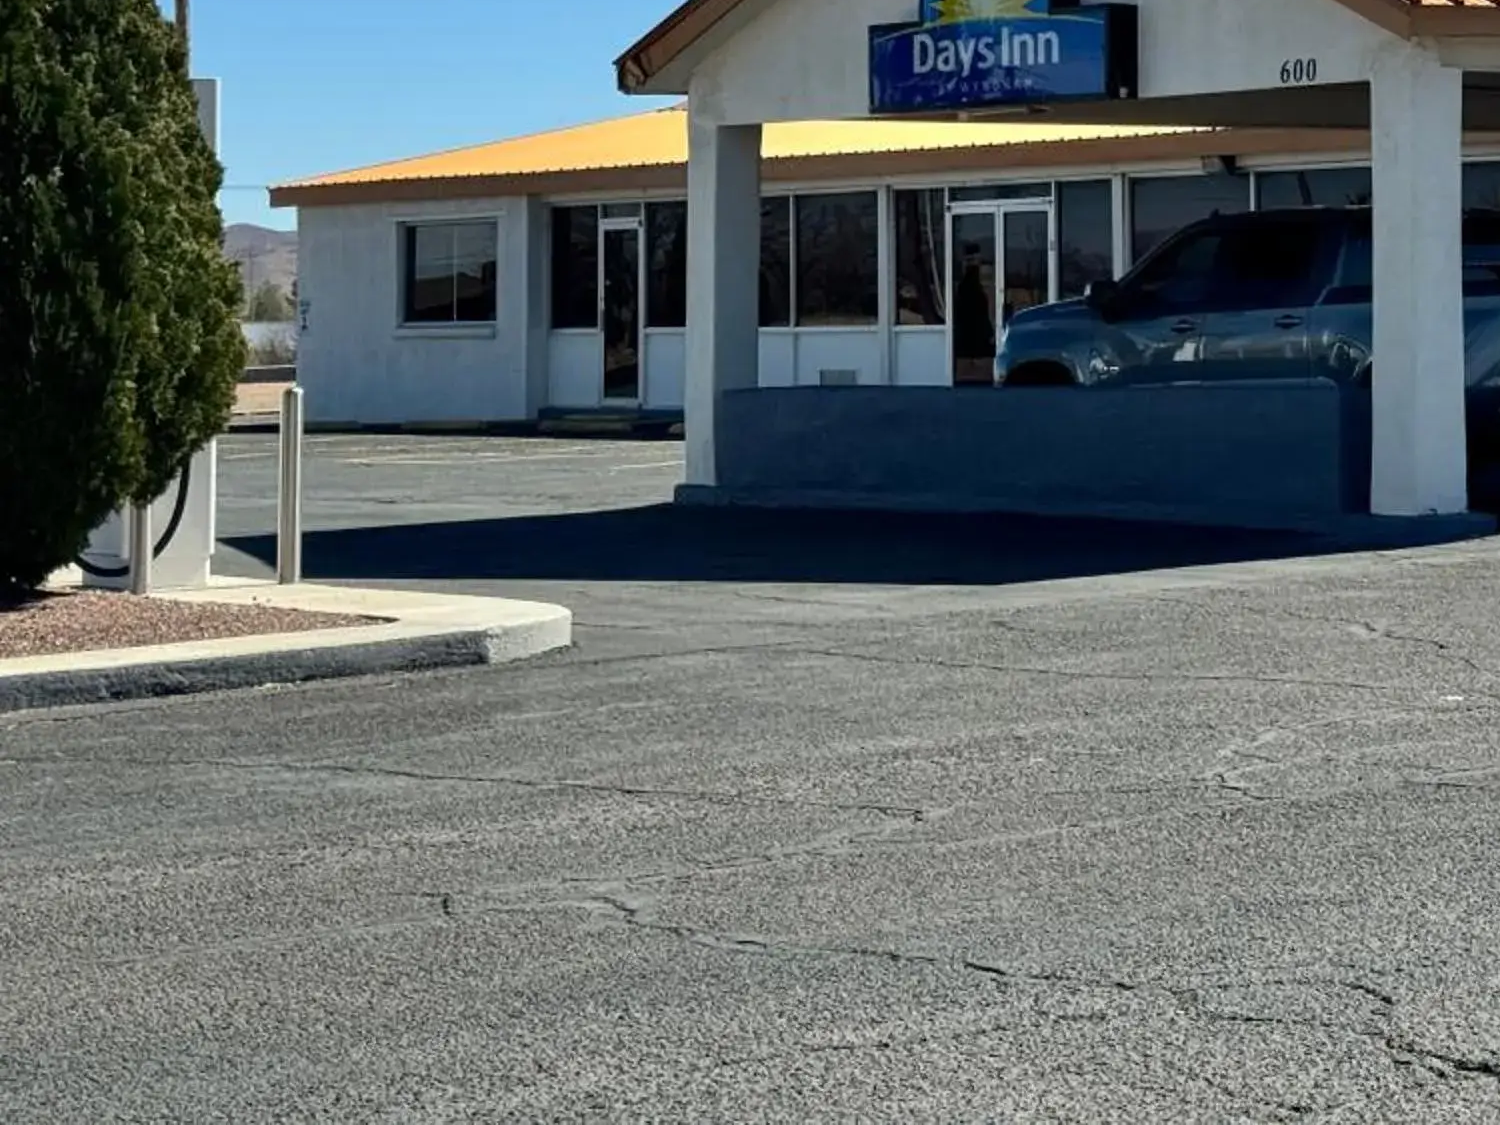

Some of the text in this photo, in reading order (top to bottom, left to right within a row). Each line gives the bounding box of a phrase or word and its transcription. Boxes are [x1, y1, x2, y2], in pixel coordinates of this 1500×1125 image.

[912, 26, 1060, 78] Days Inn
[1280, 58, 1317, 84] 600
